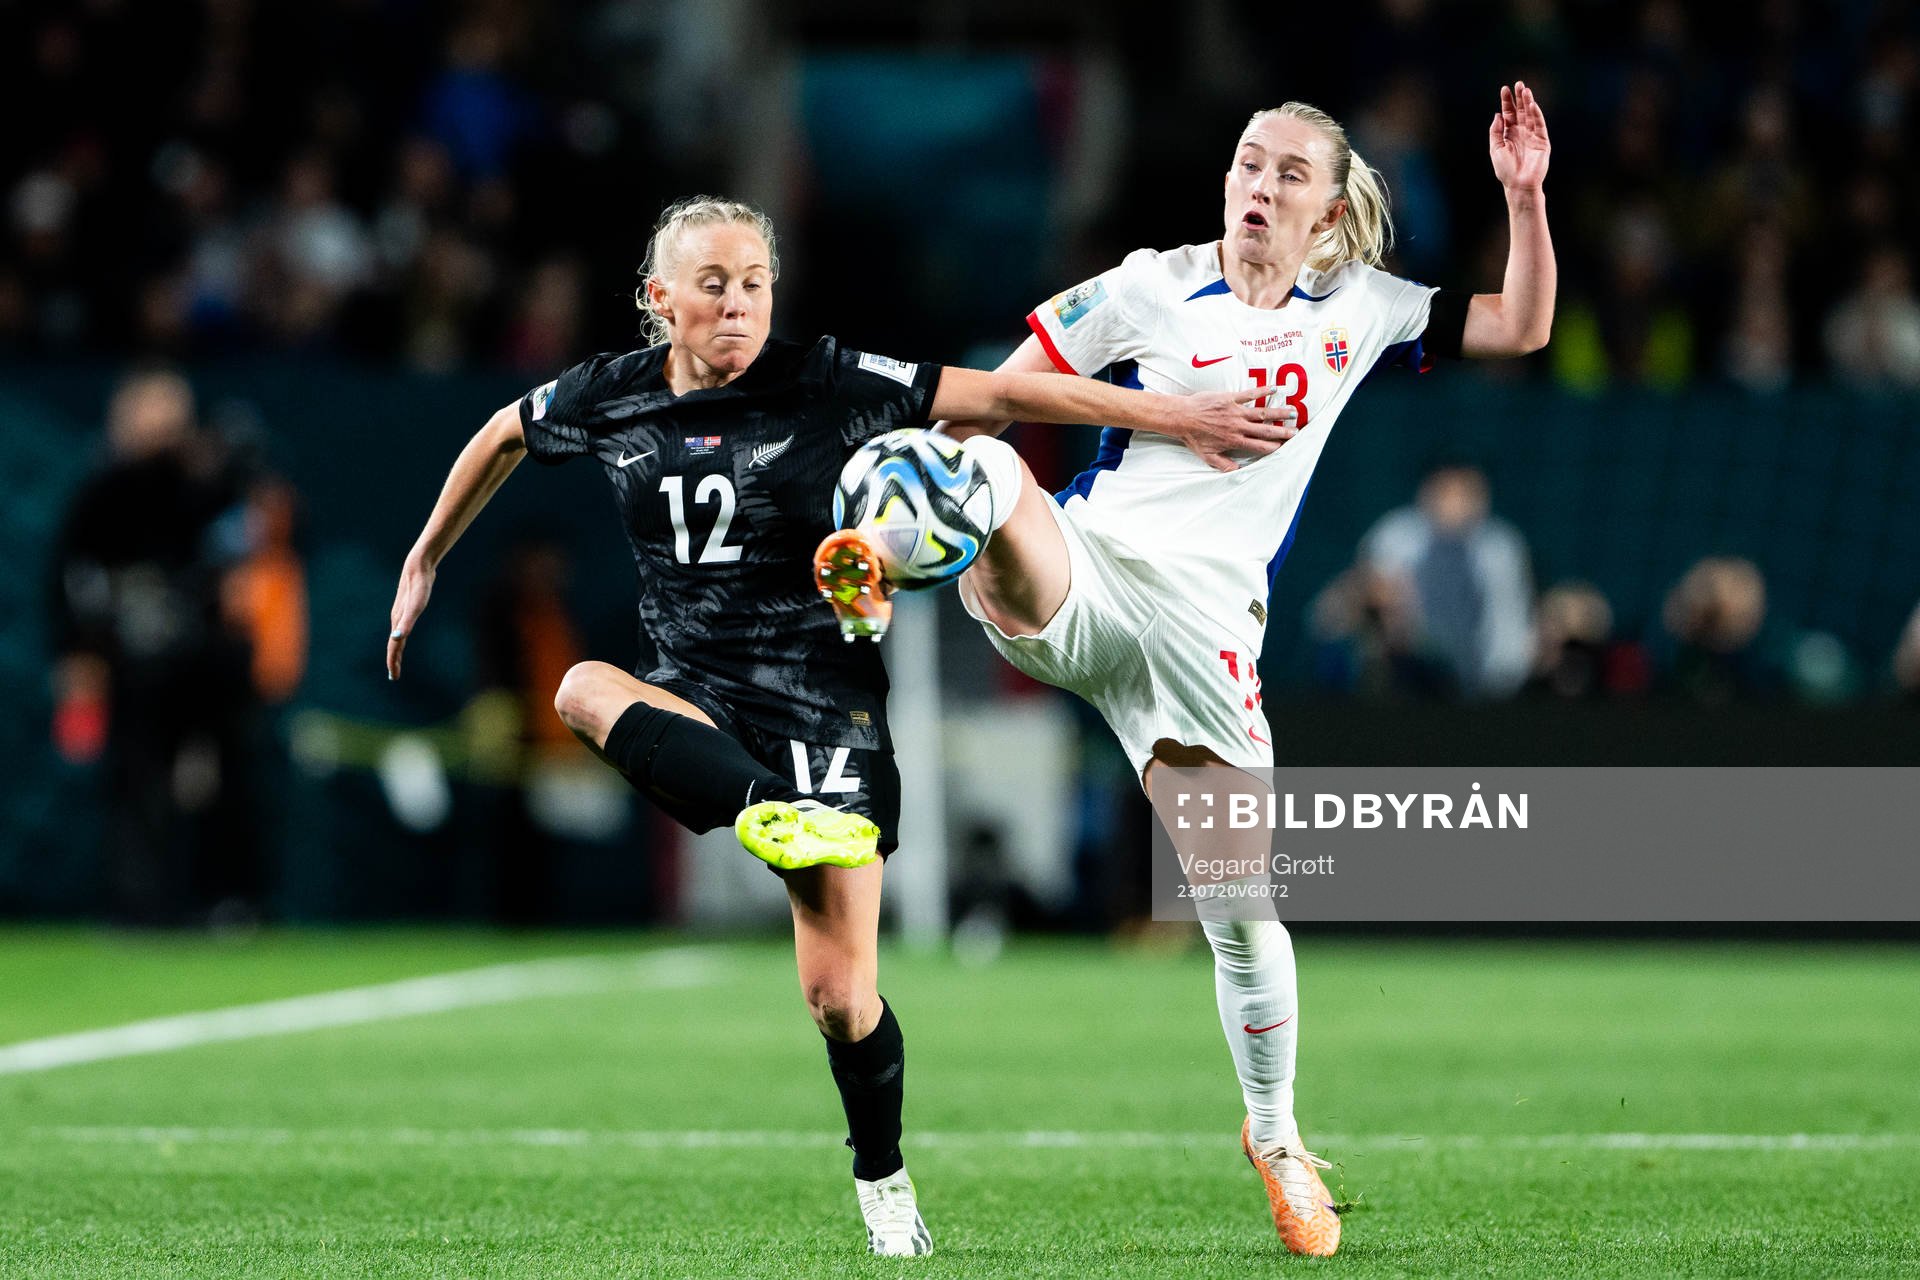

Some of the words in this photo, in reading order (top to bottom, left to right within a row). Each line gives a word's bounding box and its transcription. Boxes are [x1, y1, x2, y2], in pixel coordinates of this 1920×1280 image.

[1254, 335, 1279, 347] ZEALAND
[1265, 343, 1277, 353] JULI
[1277, 339, 1293, 350] 2023
[1248, 363, 1309, 430] 13
[658, 473, 744, 564] 12
[789, 739, 861, 795] 12
